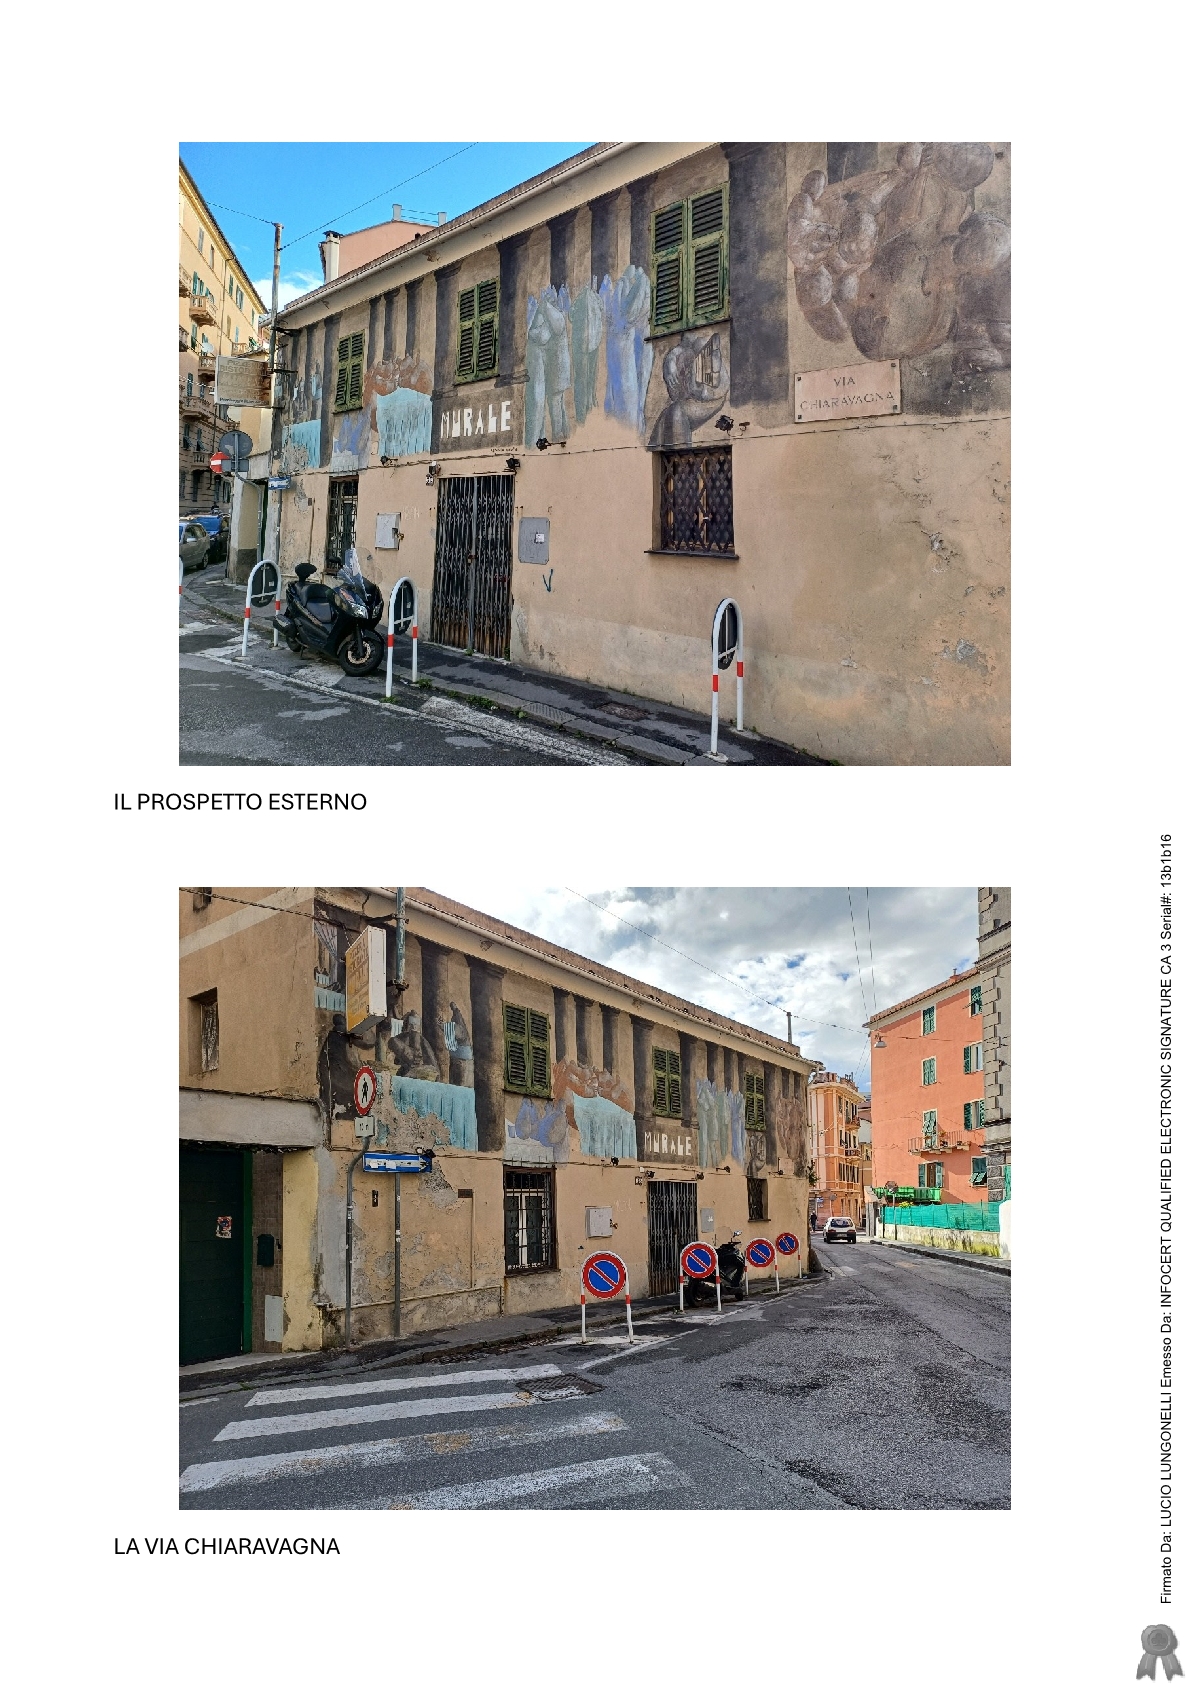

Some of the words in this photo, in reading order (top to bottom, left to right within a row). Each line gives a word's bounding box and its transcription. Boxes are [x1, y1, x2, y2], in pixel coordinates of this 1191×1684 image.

[833, 376, 856, 387] VIA
[800, 391, 895, 410] CHIARAVAGNA
[440, 400, 511, 439] MURALE
[644, 1131, 692, 1156] MURALE
